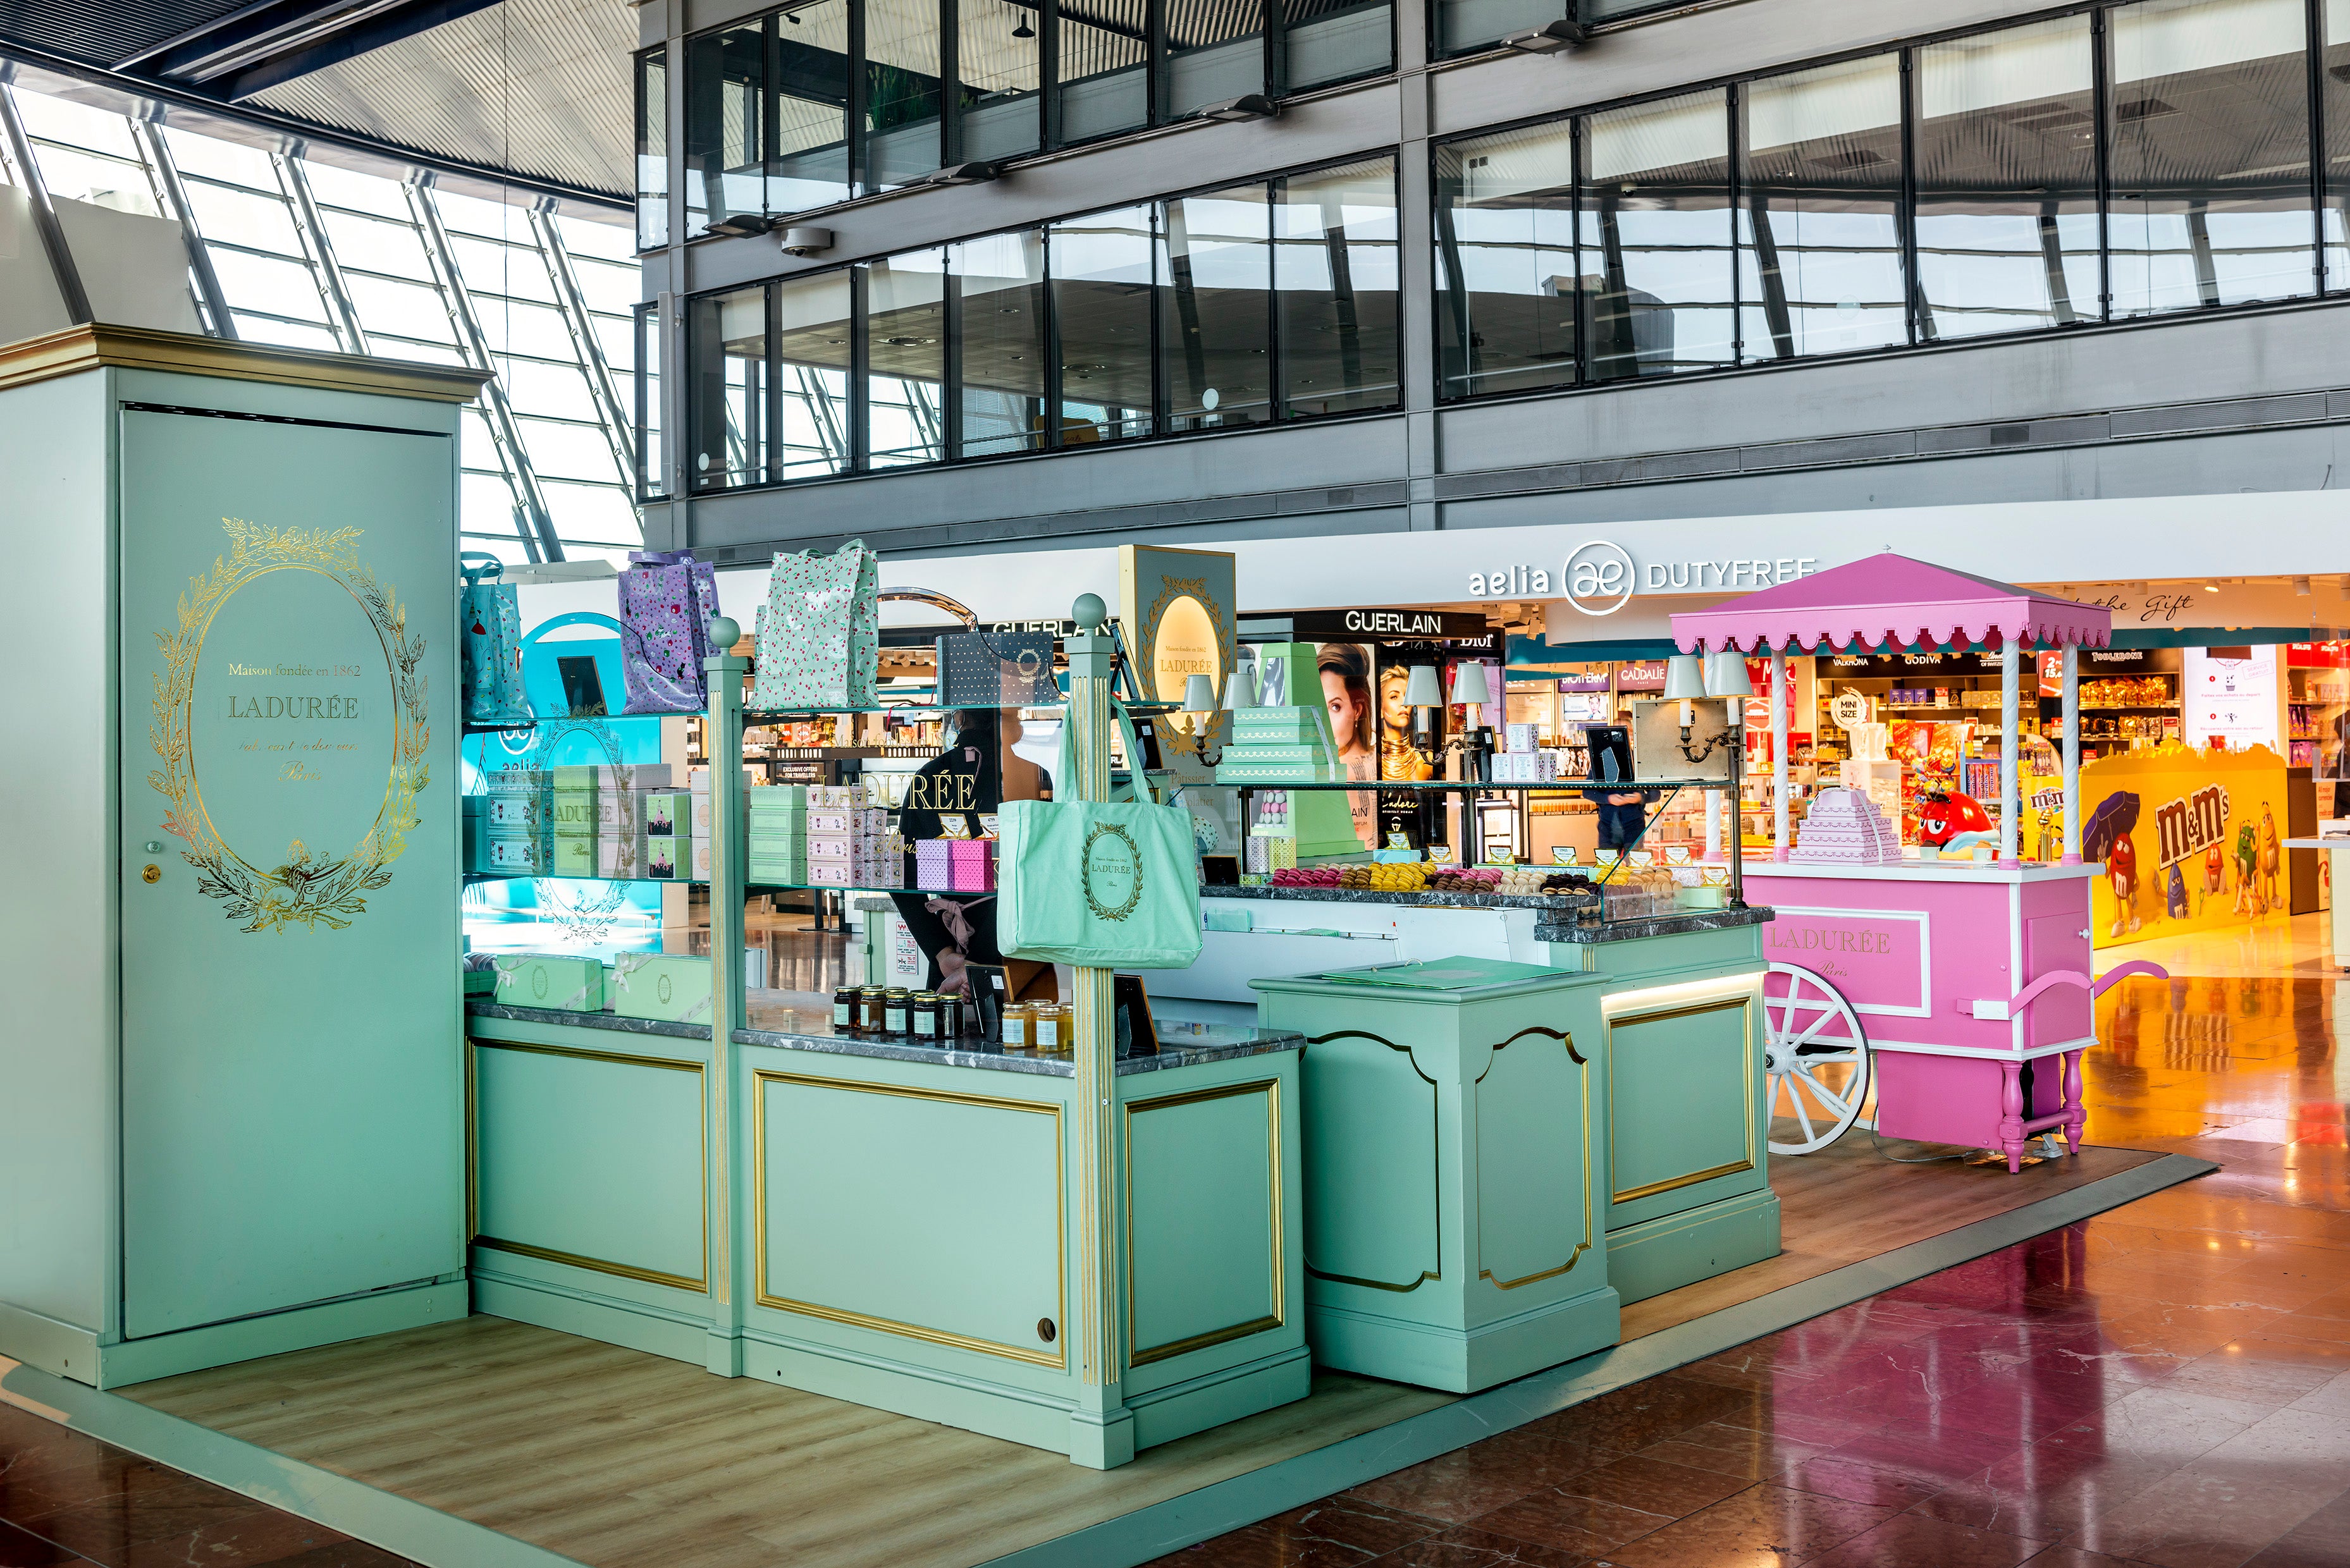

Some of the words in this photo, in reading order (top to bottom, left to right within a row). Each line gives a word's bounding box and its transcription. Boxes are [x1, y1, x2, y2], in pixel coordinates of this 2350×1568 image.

[1468, 565, 1551, 596] aelia
[2141, 595, 2194, 622] Gift
[1346, 611, 1441, 633] GUERLAIN
[1905, 656, 1941, 665] GODIVA
[2047, 657, 2055, 668] 2
[2092, 652, 2143, 661] TOBLERONE
[228, 663, 271, 676] Maison
[276, 664, 312, 676] fondée
[316, 668, 328, 677] en
[333, 665, 361, 677] 1862
[1160, 659, 1212, 673] LADURÉE
[228, 695, 359, 719] LADURÉE
[832, 734, 869, 748] Maison
[913, 738, 926, 747] en
[932, 733, 959, 747] 1862
[278, 760, 323, 781] Paris
[1171, 771, 1206, 784] Pâtissier
[818, 769, 976, 810] LADURÉE
[877, 826, 918, 854] Paris
[572, 843, 590, 855] Paris
[1092, 864, 1131, 874] LADURÉE
[1769, 927, 1891, 954] LADURÉE
[1816, 960, 1848, 977] Paris
